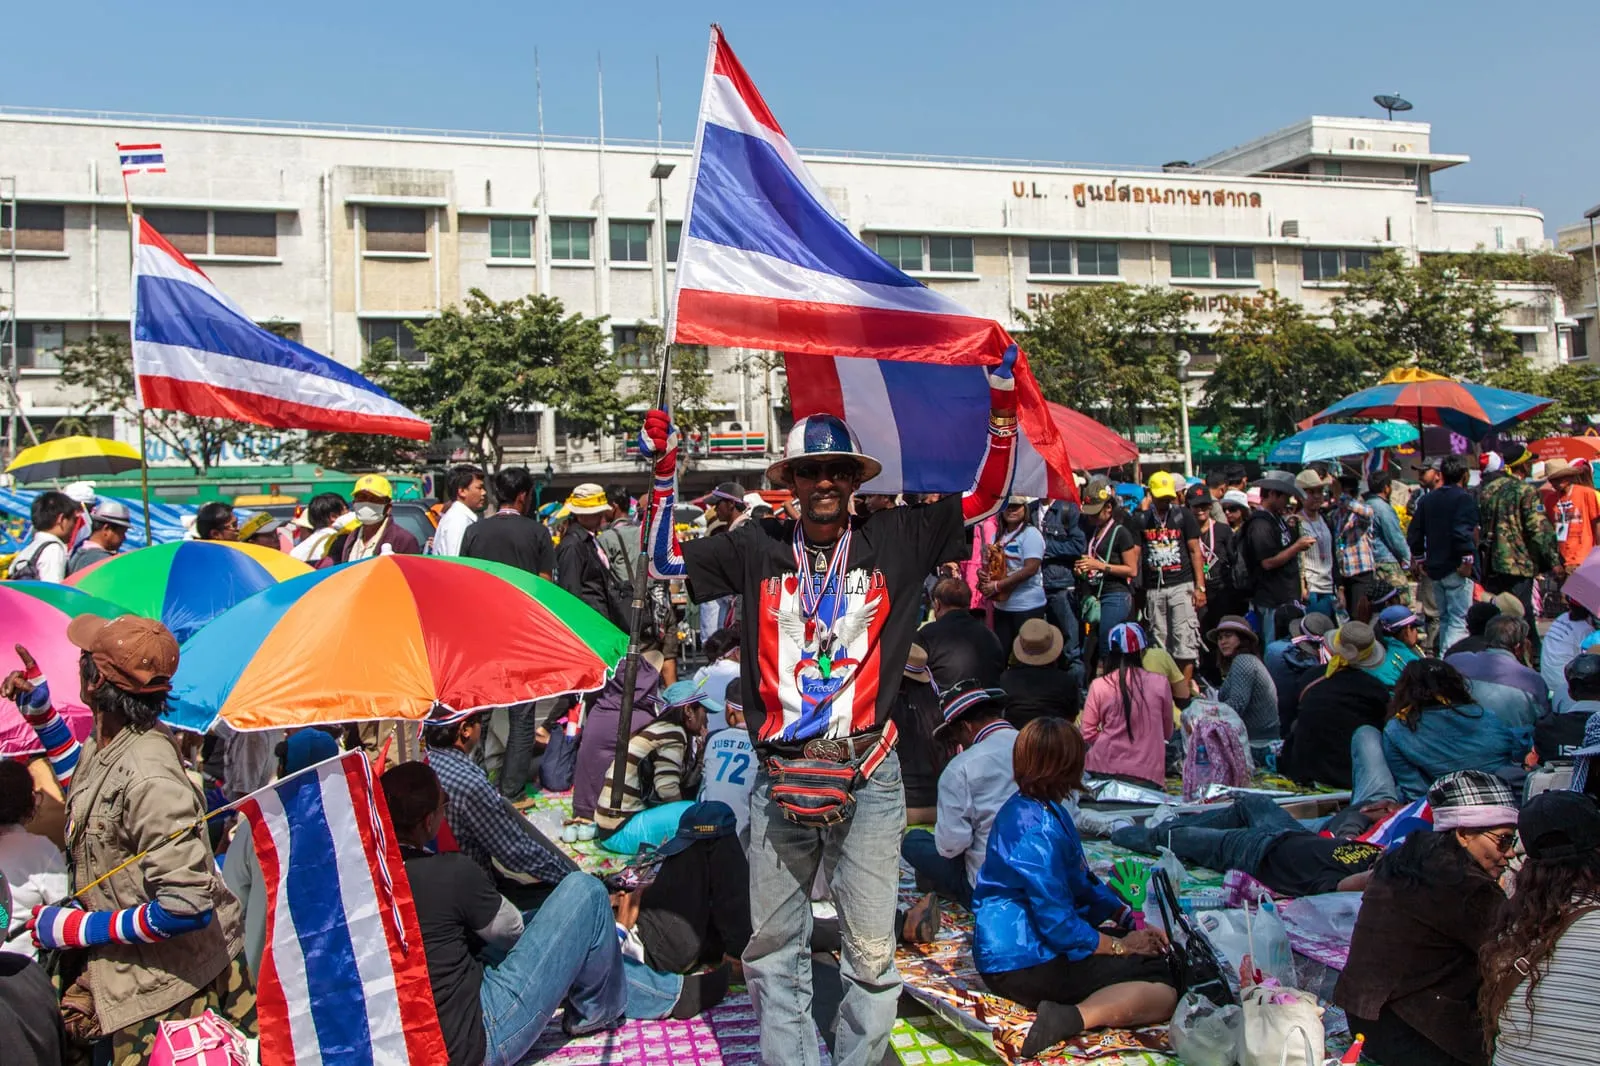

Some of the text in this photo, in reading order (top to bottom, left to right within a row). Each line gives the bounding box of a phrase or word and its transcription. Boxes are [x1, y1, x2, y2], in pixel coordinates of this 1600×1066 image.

[1072, 178, 1262, 208] ศูนย์สอนภาษาสากล
[712, 739, 736, 750] JUST
[715, 751, 751, 786] 72
